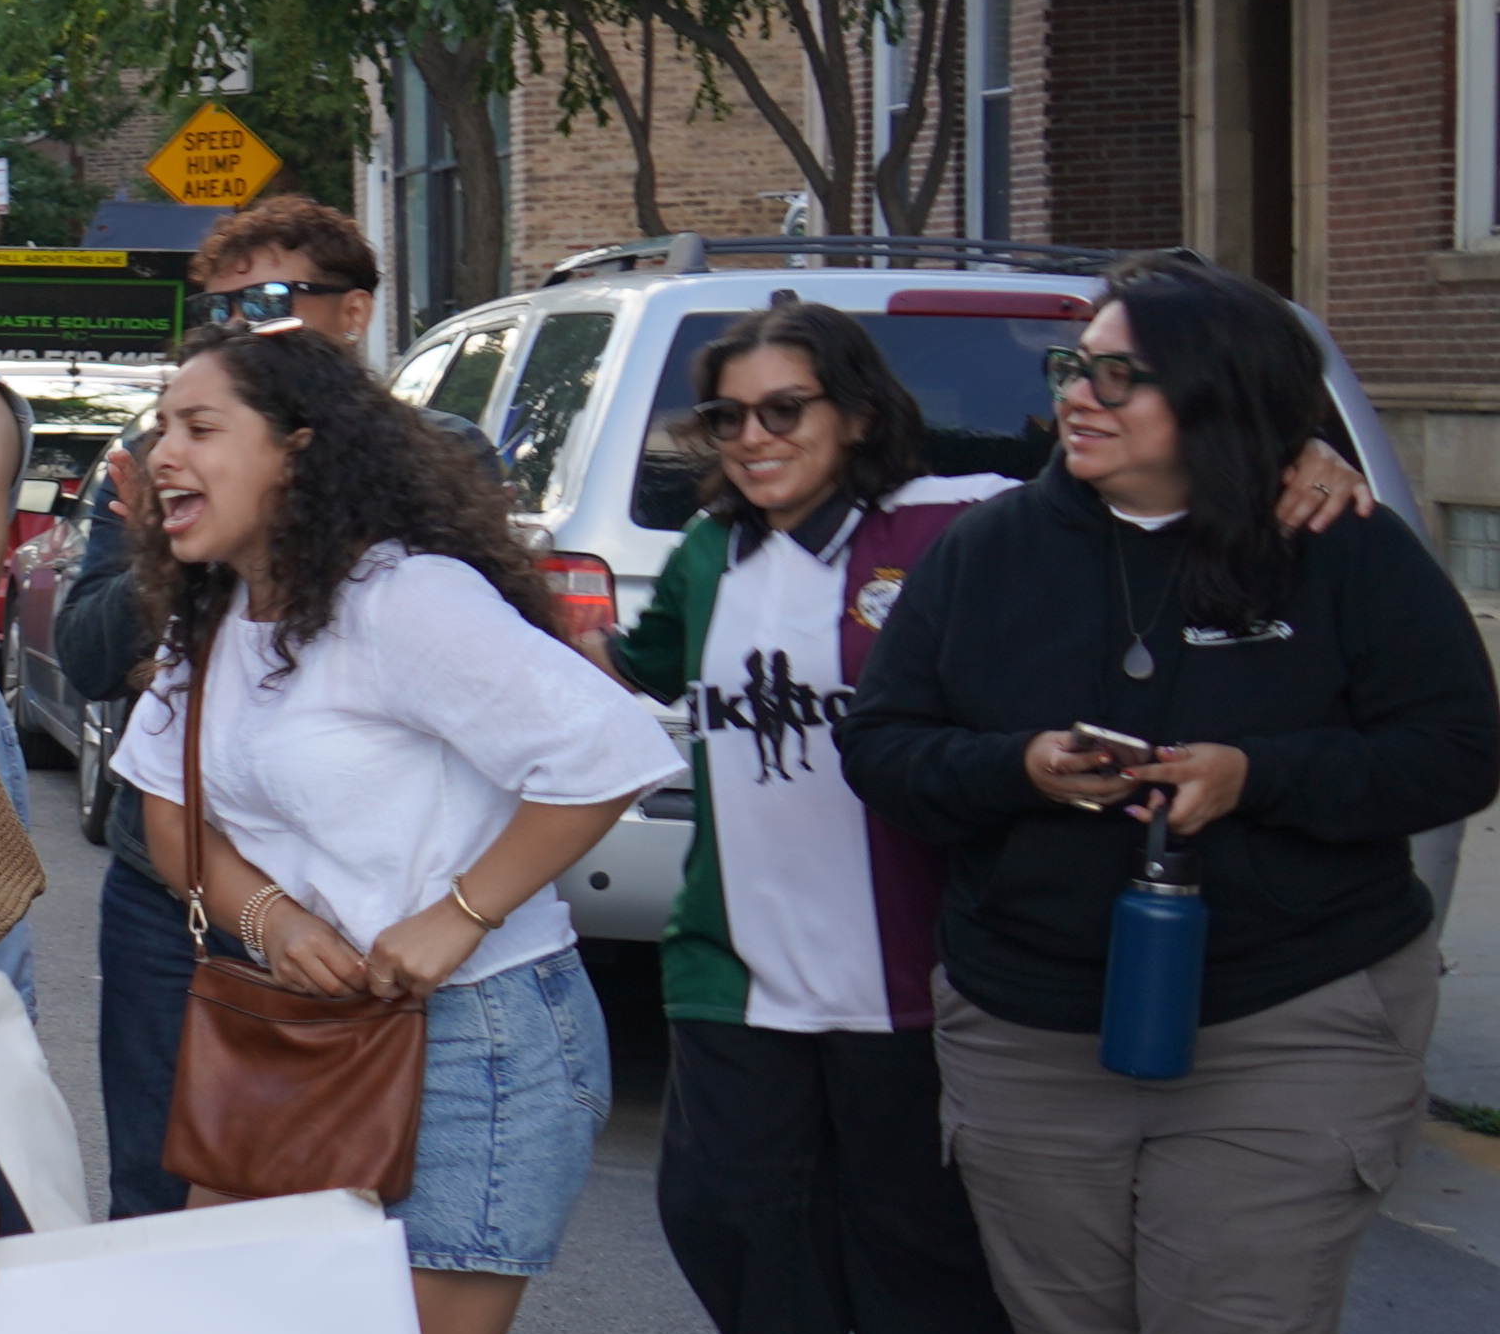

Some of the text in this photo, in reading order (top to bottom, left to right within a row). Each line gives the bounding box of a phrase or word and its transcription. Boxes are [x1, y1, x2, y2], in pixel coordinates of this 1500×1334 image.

[184, 129, 244, 151] SPEED
[186, 154, 241, 175] HUMP
[182, 177, 247, 199] AHEAD
[24, 254, 64, 264] ABOVE
[67, 255, 94, 264] THIS
[96, 255, 123, 265] LINE
[57, 317, 171, 331] SOLUTIONS
